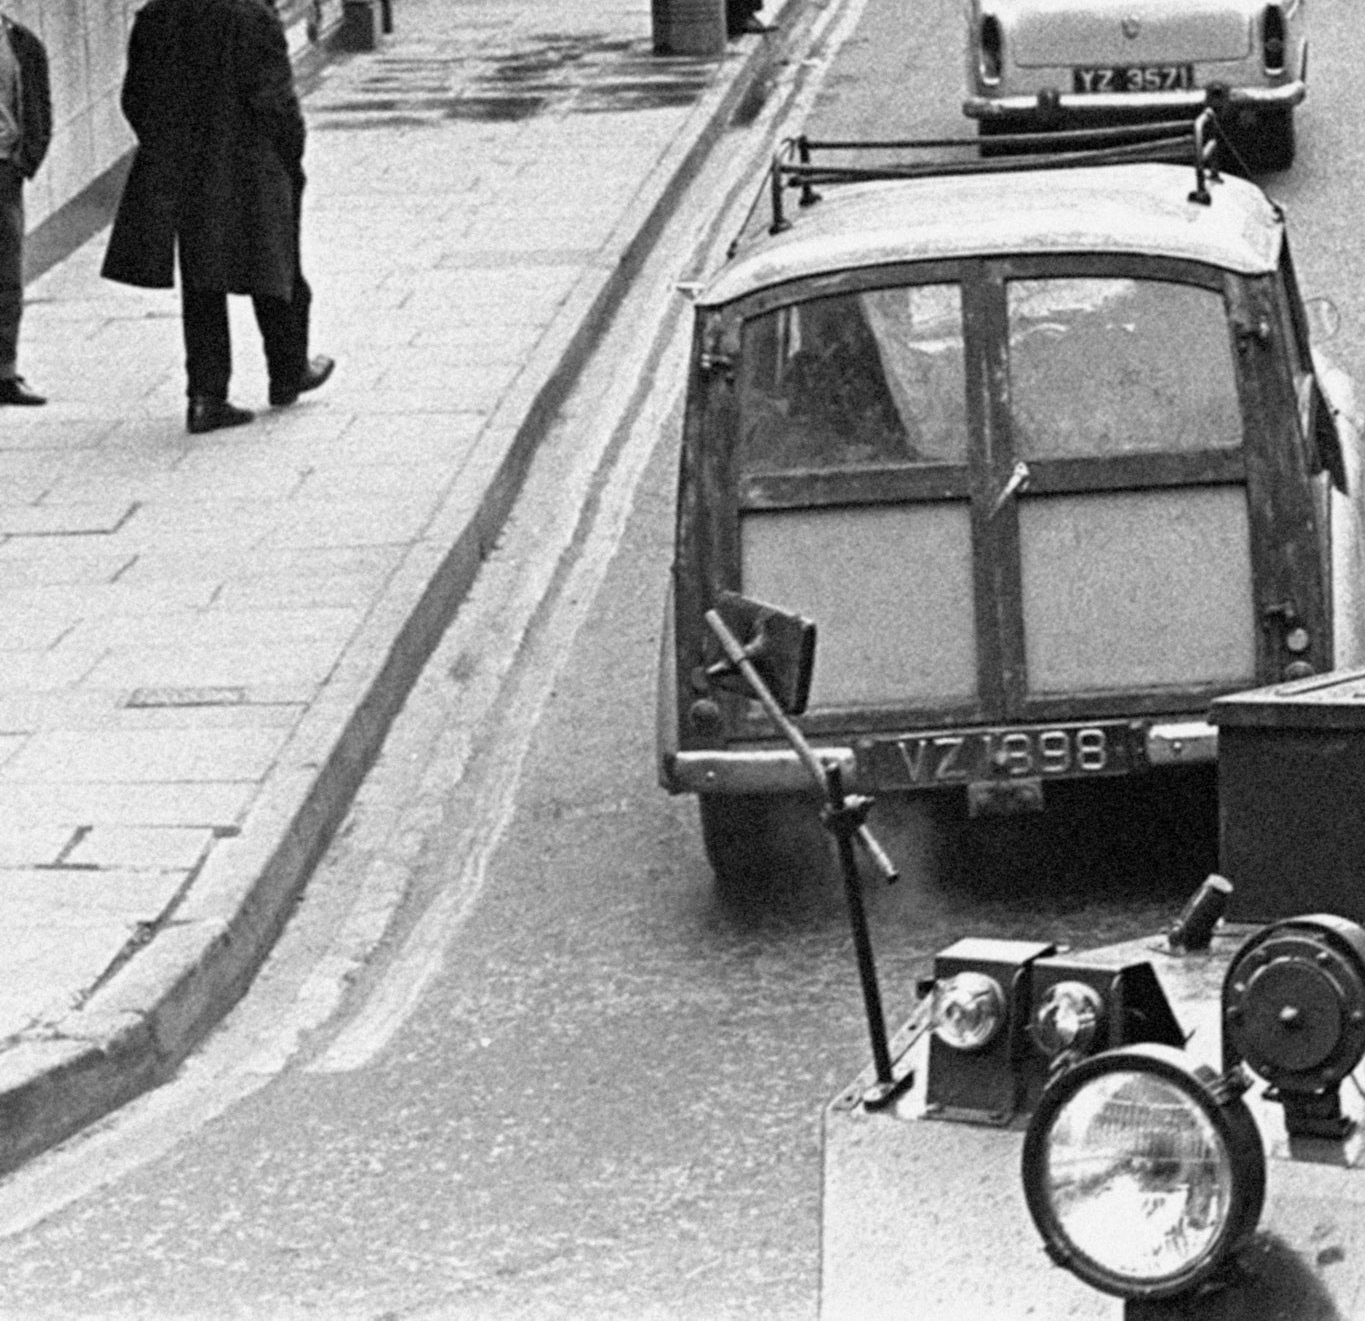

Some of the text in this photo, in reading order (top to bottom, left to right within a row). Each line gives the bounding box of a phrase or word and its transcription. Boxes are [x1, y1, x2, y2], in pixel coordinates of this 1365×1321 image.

[1080, 66, 1189, 92] YZ 3571
[898, 736, 966, 781] VZ
